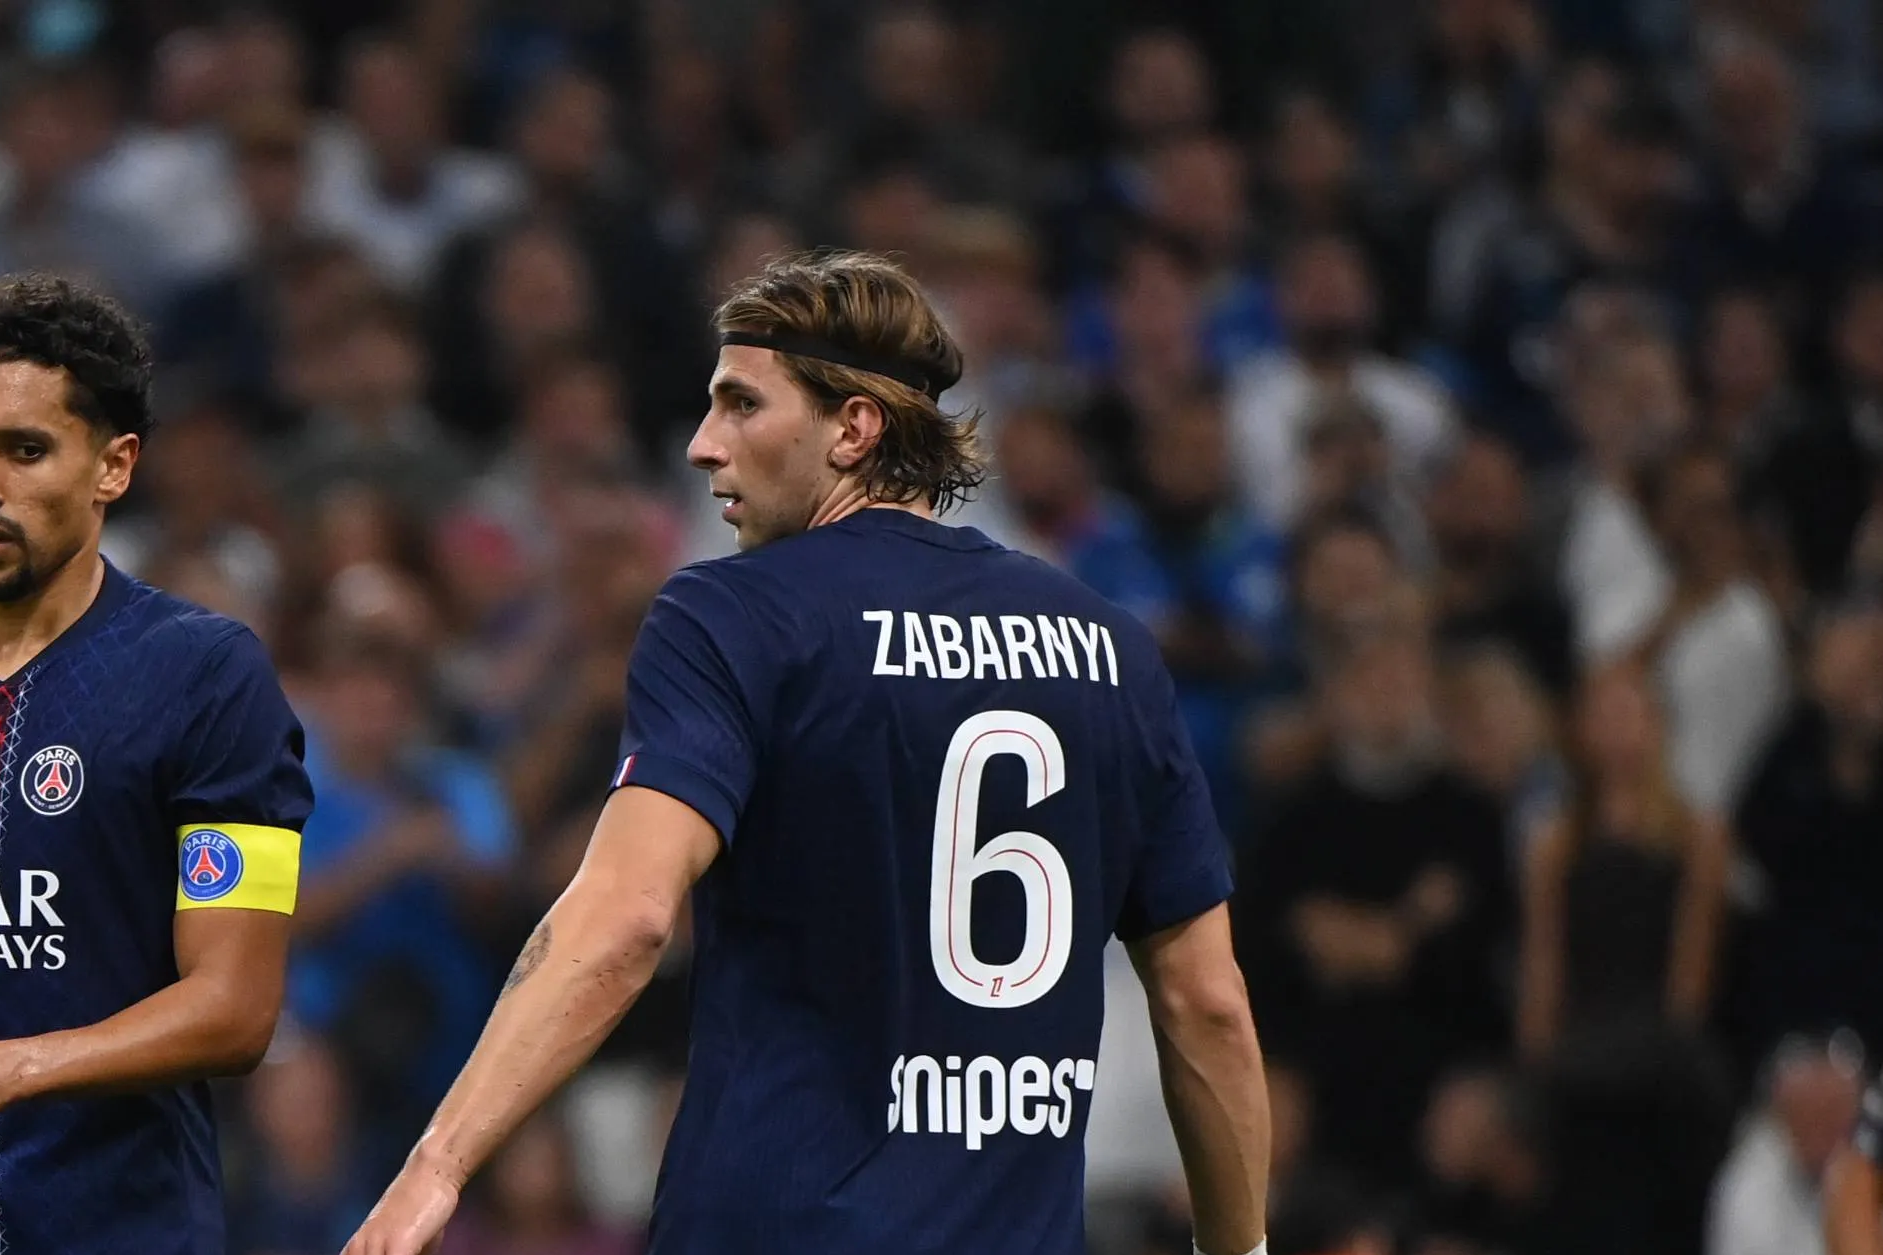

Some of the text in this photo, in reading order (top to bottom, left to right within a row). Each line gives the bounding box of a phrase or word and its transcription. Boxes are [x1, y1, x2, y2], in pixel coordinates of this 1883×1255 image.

[862, 609, 1119, 687] ZABARNYI
[35, 749, 77, 766] PARIS
[184, 834, 228, 852] PARIS
[929, 709, 1073, 1009] 6
[887, 1053, 1075, 1151] snipes
